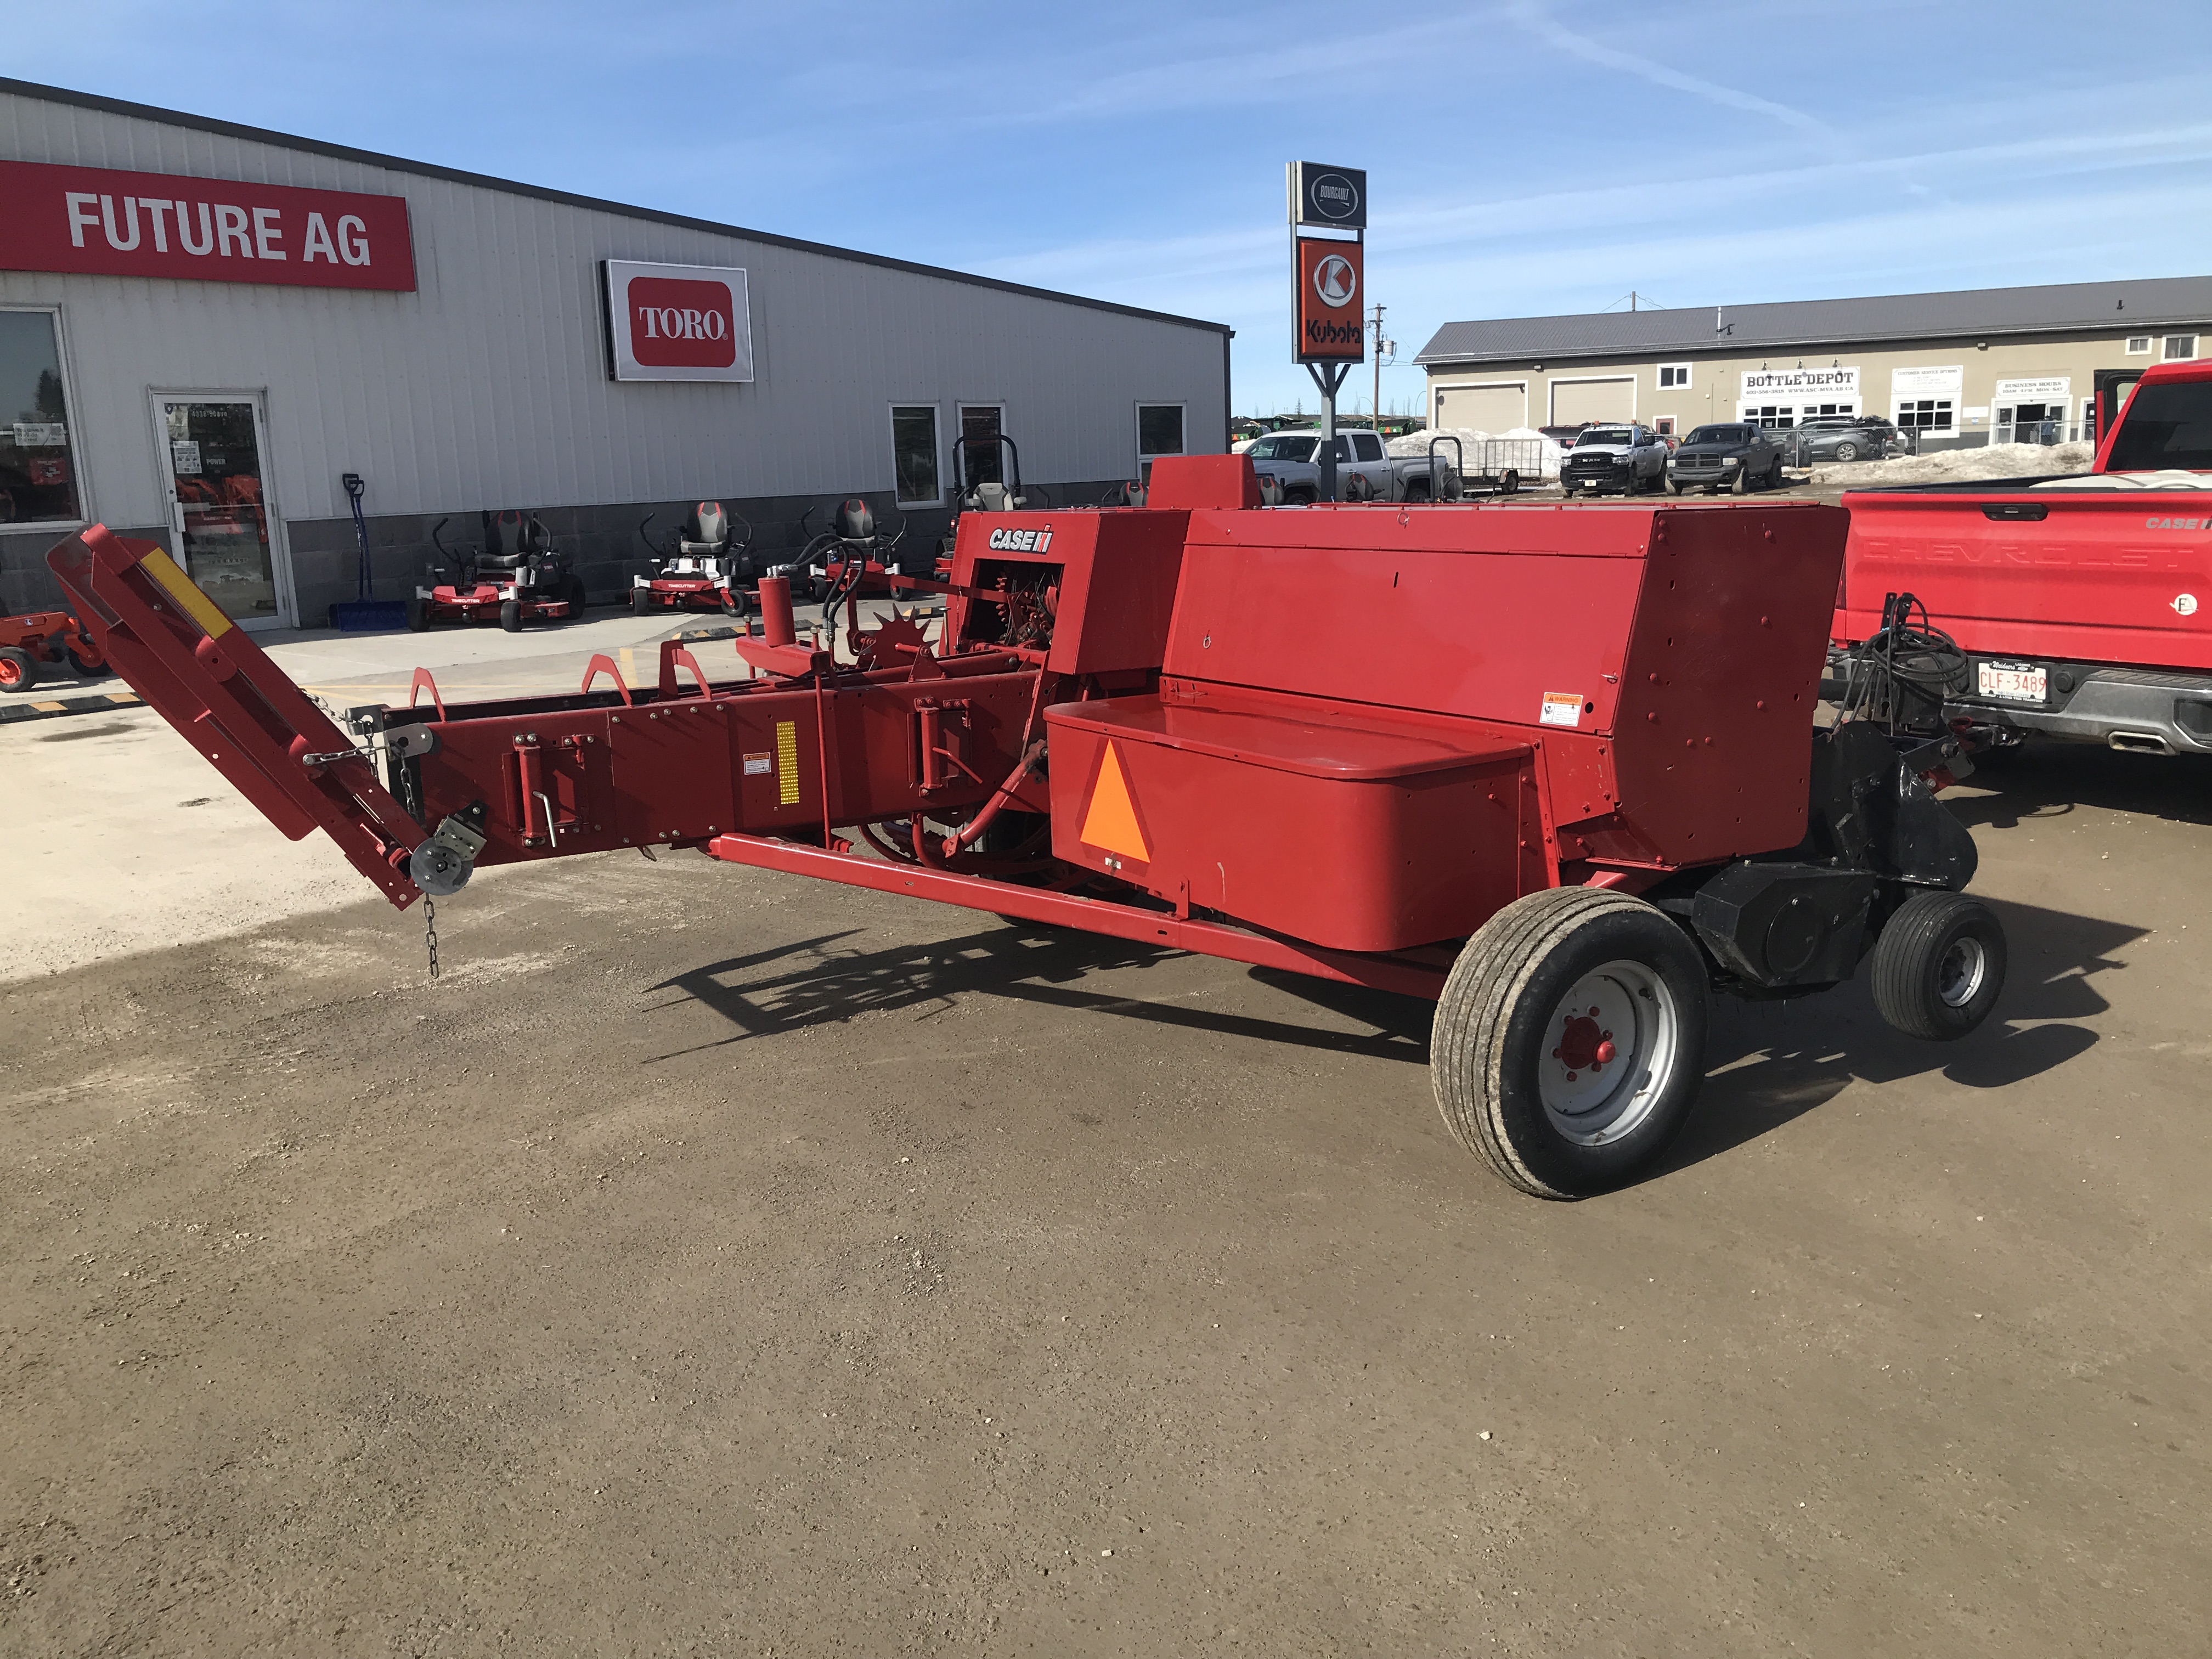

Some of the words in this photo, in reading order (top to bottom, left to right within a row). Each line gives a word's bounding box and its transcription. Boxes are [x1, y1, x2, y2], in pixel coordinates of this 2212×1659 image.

[1320, 185, 1350, 201] BOURGAULT
[65, 191, 286, 260] FUTURE
[303, 212, 370, 266] AG
[639, 307, 725, 340] TORO
[1306, 319, 1361, 344] Kubota
[1746, 374, 1802, 387] BOTTLE
[1806, 371, 1854, 385] DEPOT
[2145, 517, 2199, 530] CASE
[989, 529, 1036, 551] CASE
[1864, 540, 2194, 567] CHEVROLET
[1980, 672, 2047, 692] CLF-3489
